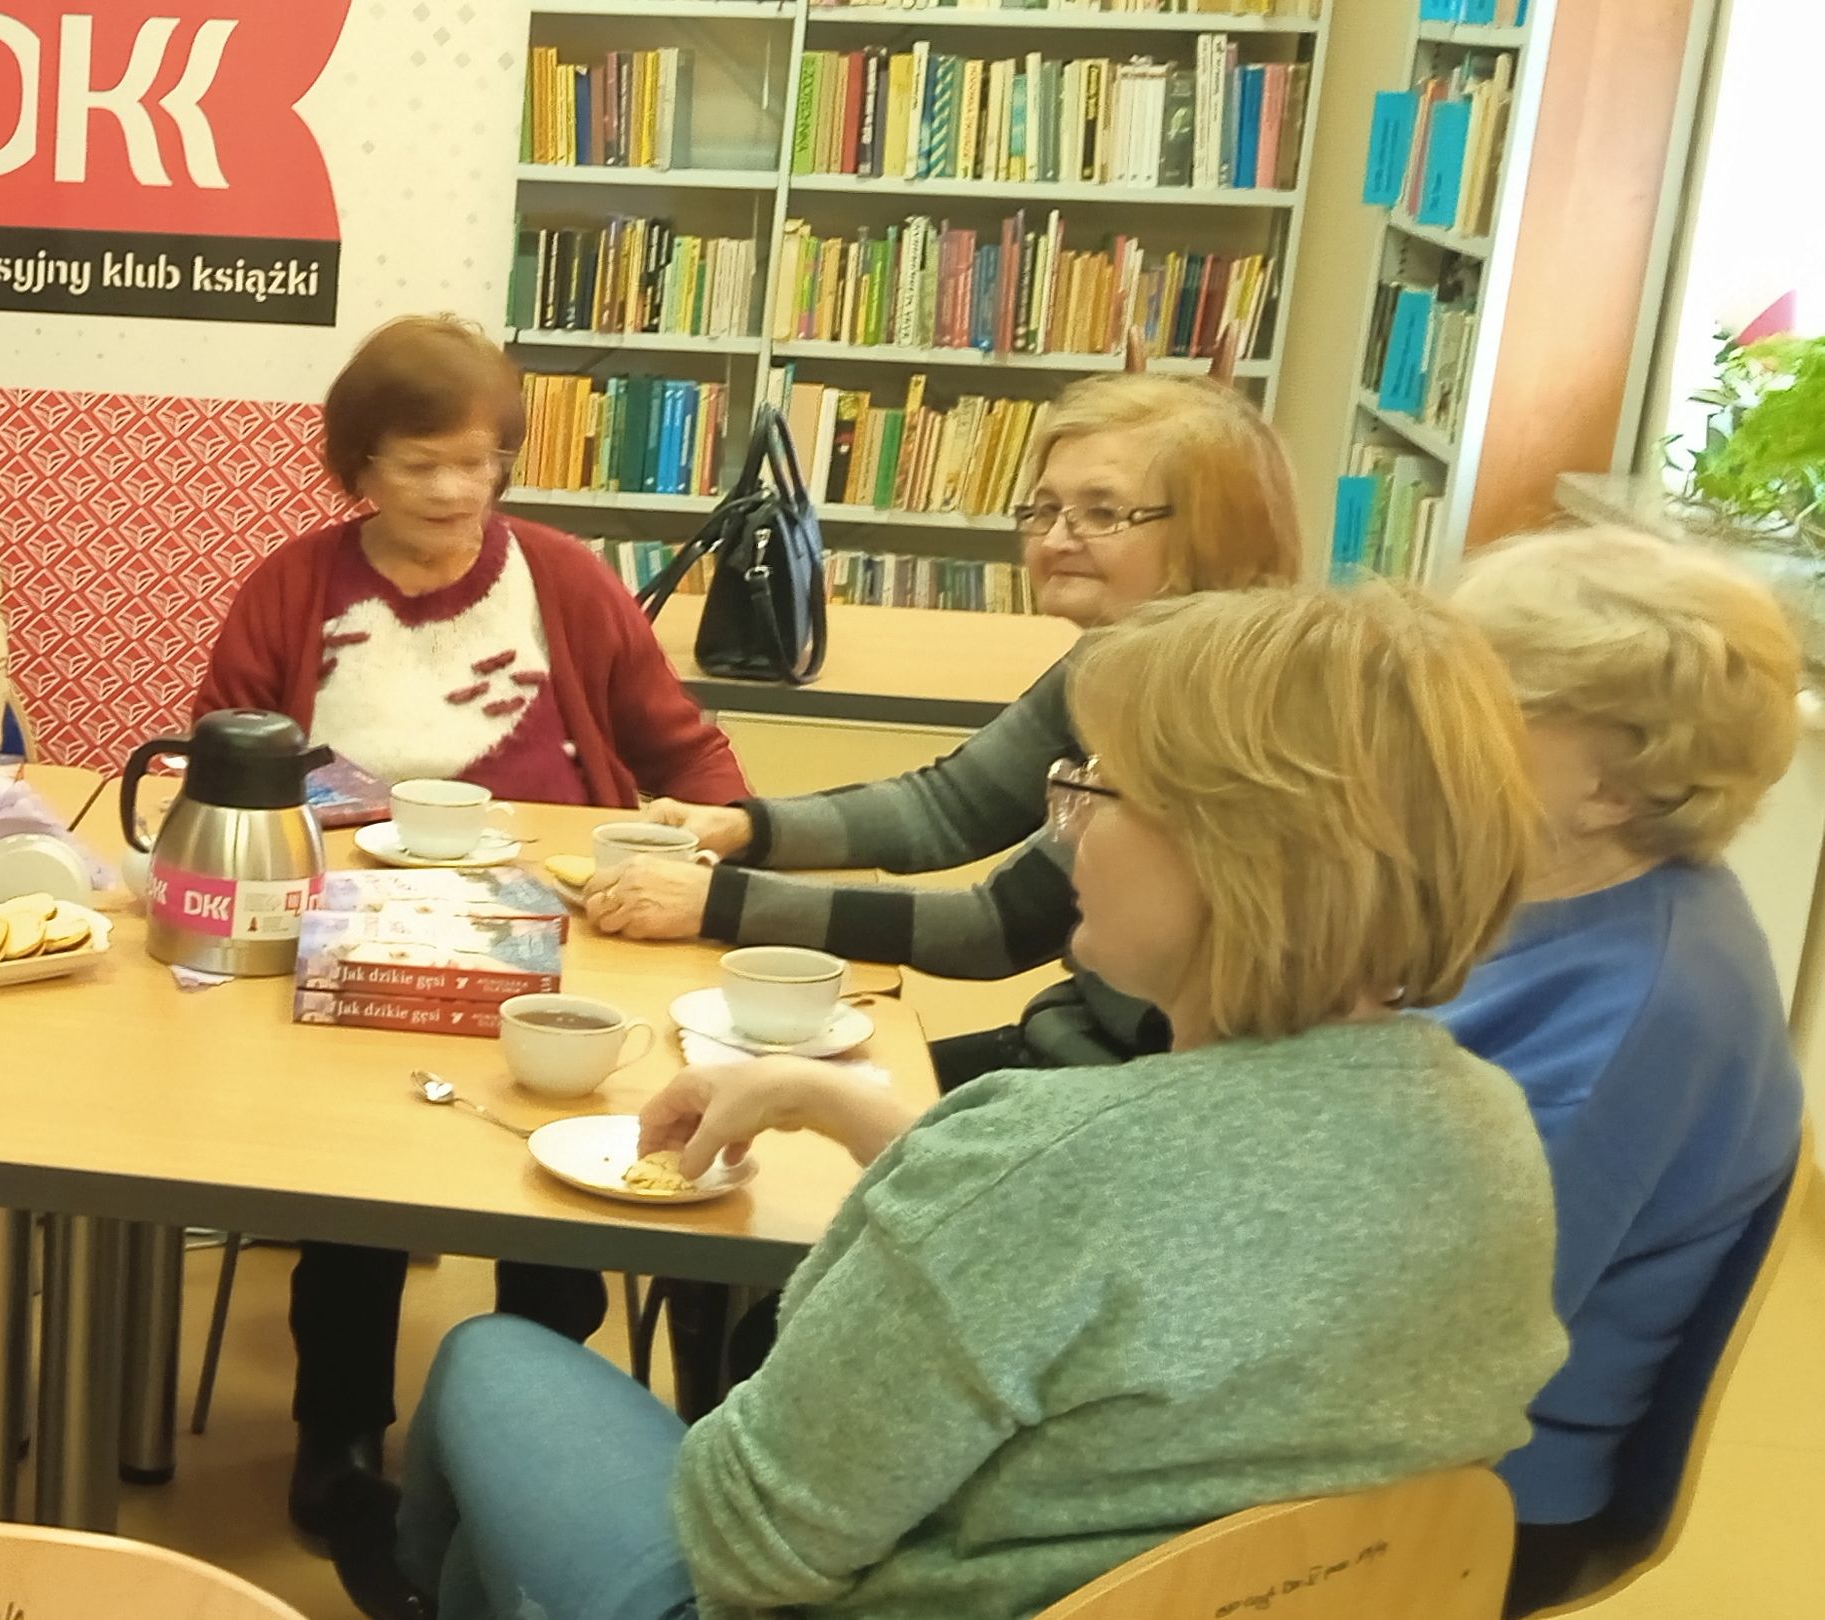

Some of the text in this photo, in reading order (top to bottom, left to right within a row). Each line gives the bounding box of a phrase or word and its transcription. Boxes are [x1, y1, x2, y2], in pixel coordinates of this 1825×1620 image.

[103, 251, 181, 290] klub
[192, 256, 320, 301] książki
[184, 890, 232, 921] DKK
[341, 966, 446, 990] Jak dzikie gęsi
[337, 1001, 441, 1024] Jak dzikie gęsi
